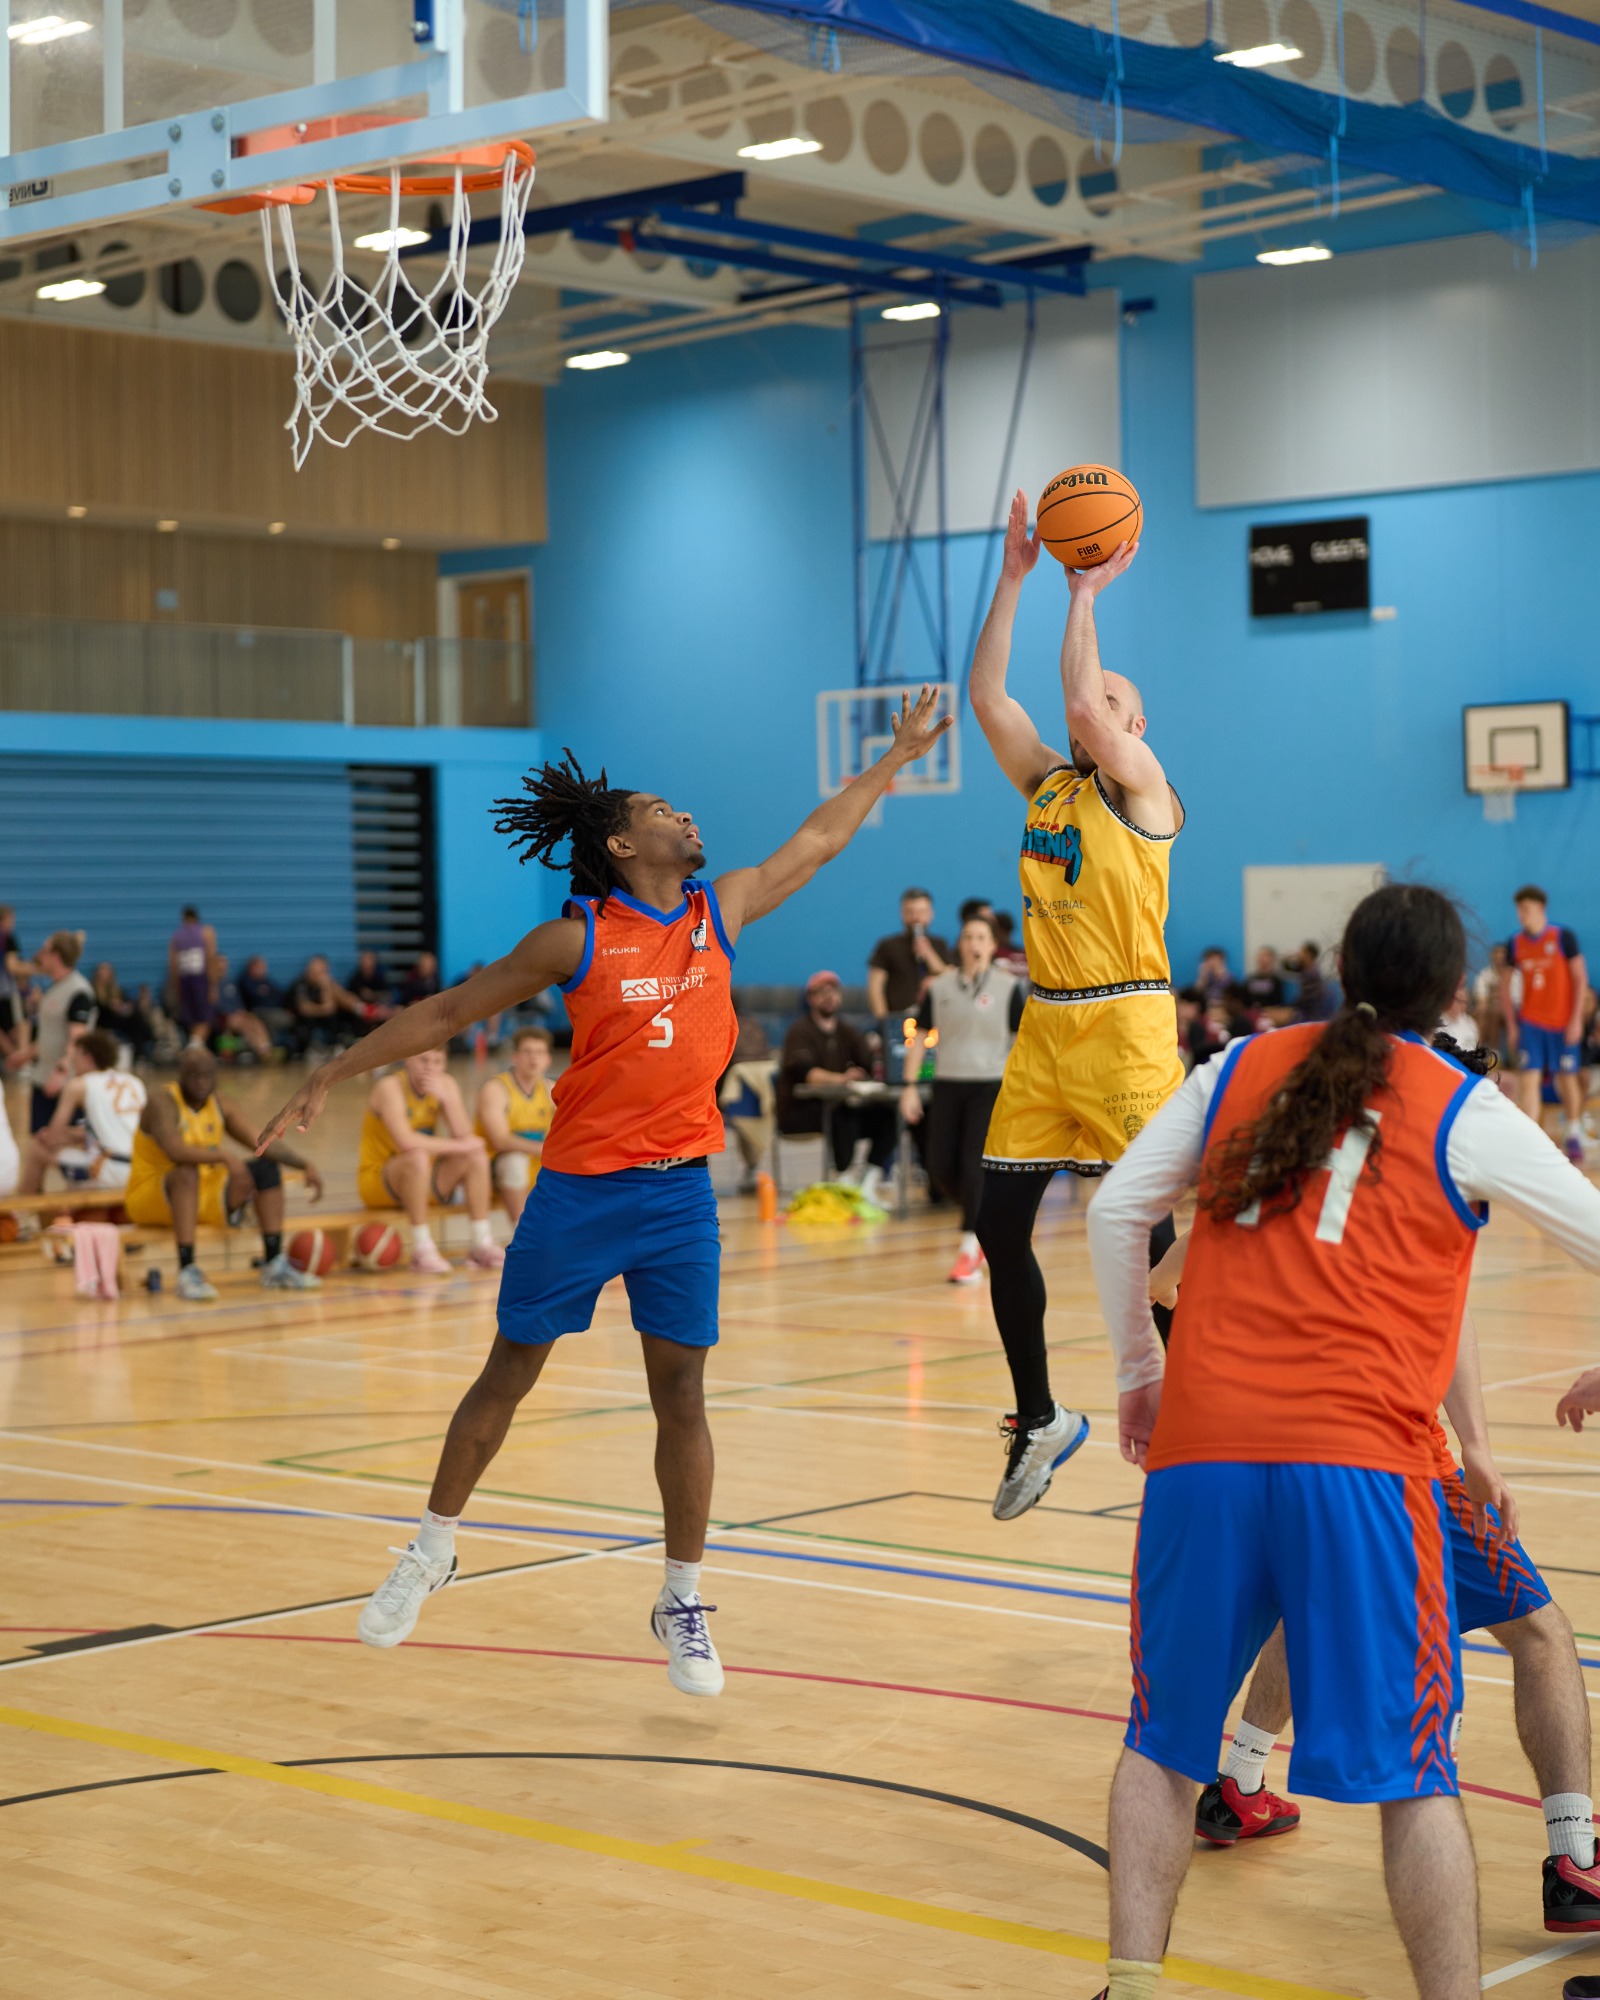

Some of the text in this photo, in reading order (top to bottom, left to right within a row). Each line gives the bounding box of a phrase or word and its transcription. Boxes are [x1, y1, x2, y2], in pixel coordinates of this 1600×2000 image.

[1043, 472, 1109, 500] Wilson
[1076, 543, 1101, 557] FIBA
[609, 946, 640, 955] KUKRI
[661, 973, 708, 1000] DERBY
[647, 1003, 674, 1049] 5
[1103, 1090, 1163, 1105] NORDICA
[1106, 1102, 1160, 1117] STUDIOS
